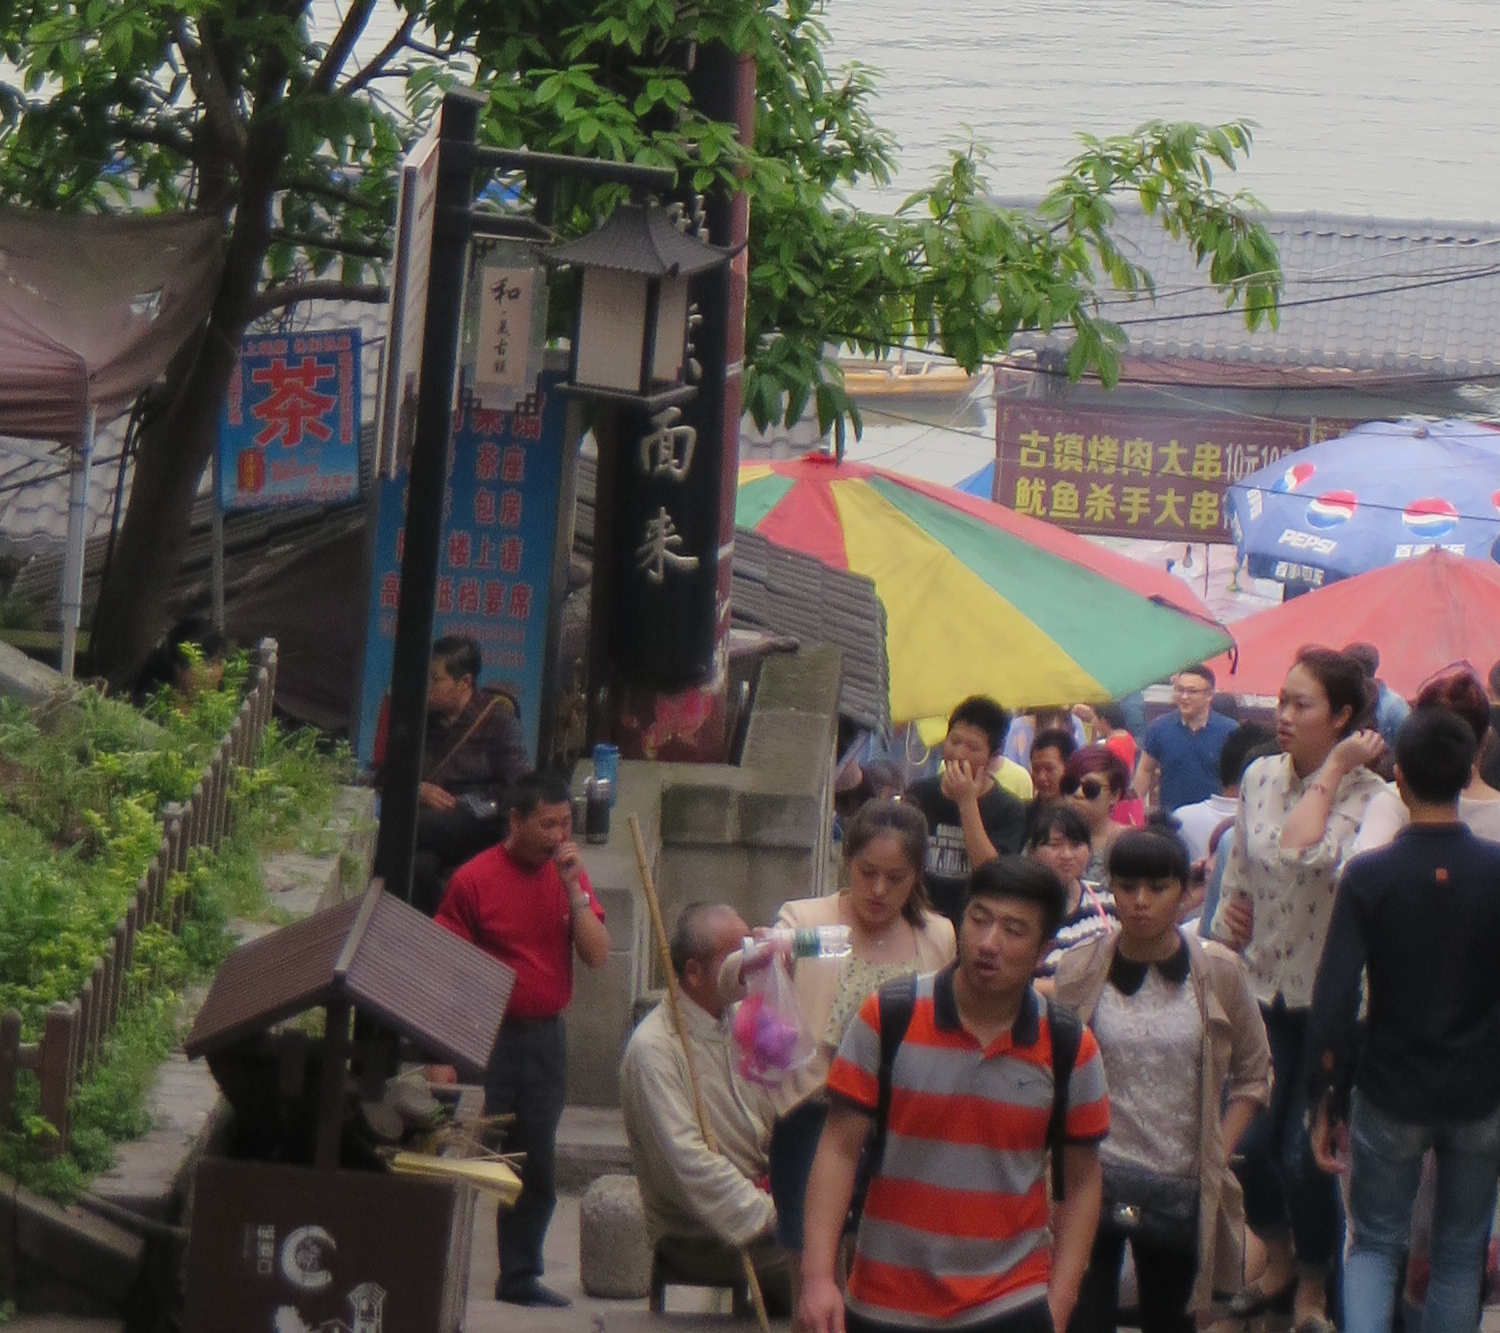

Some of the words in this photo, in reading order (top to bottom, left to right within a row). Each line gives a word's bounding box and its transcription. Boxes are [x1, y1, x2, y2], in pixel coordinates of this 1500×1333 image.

[252, 355, 338, 448] 茶
[1018, 429, 1222, 481] 古镇烤肉大串
[1014, 475, 1221, 531] 鱿鱼杀手大串
[1277, 528, 1338, 557] PEPSI
